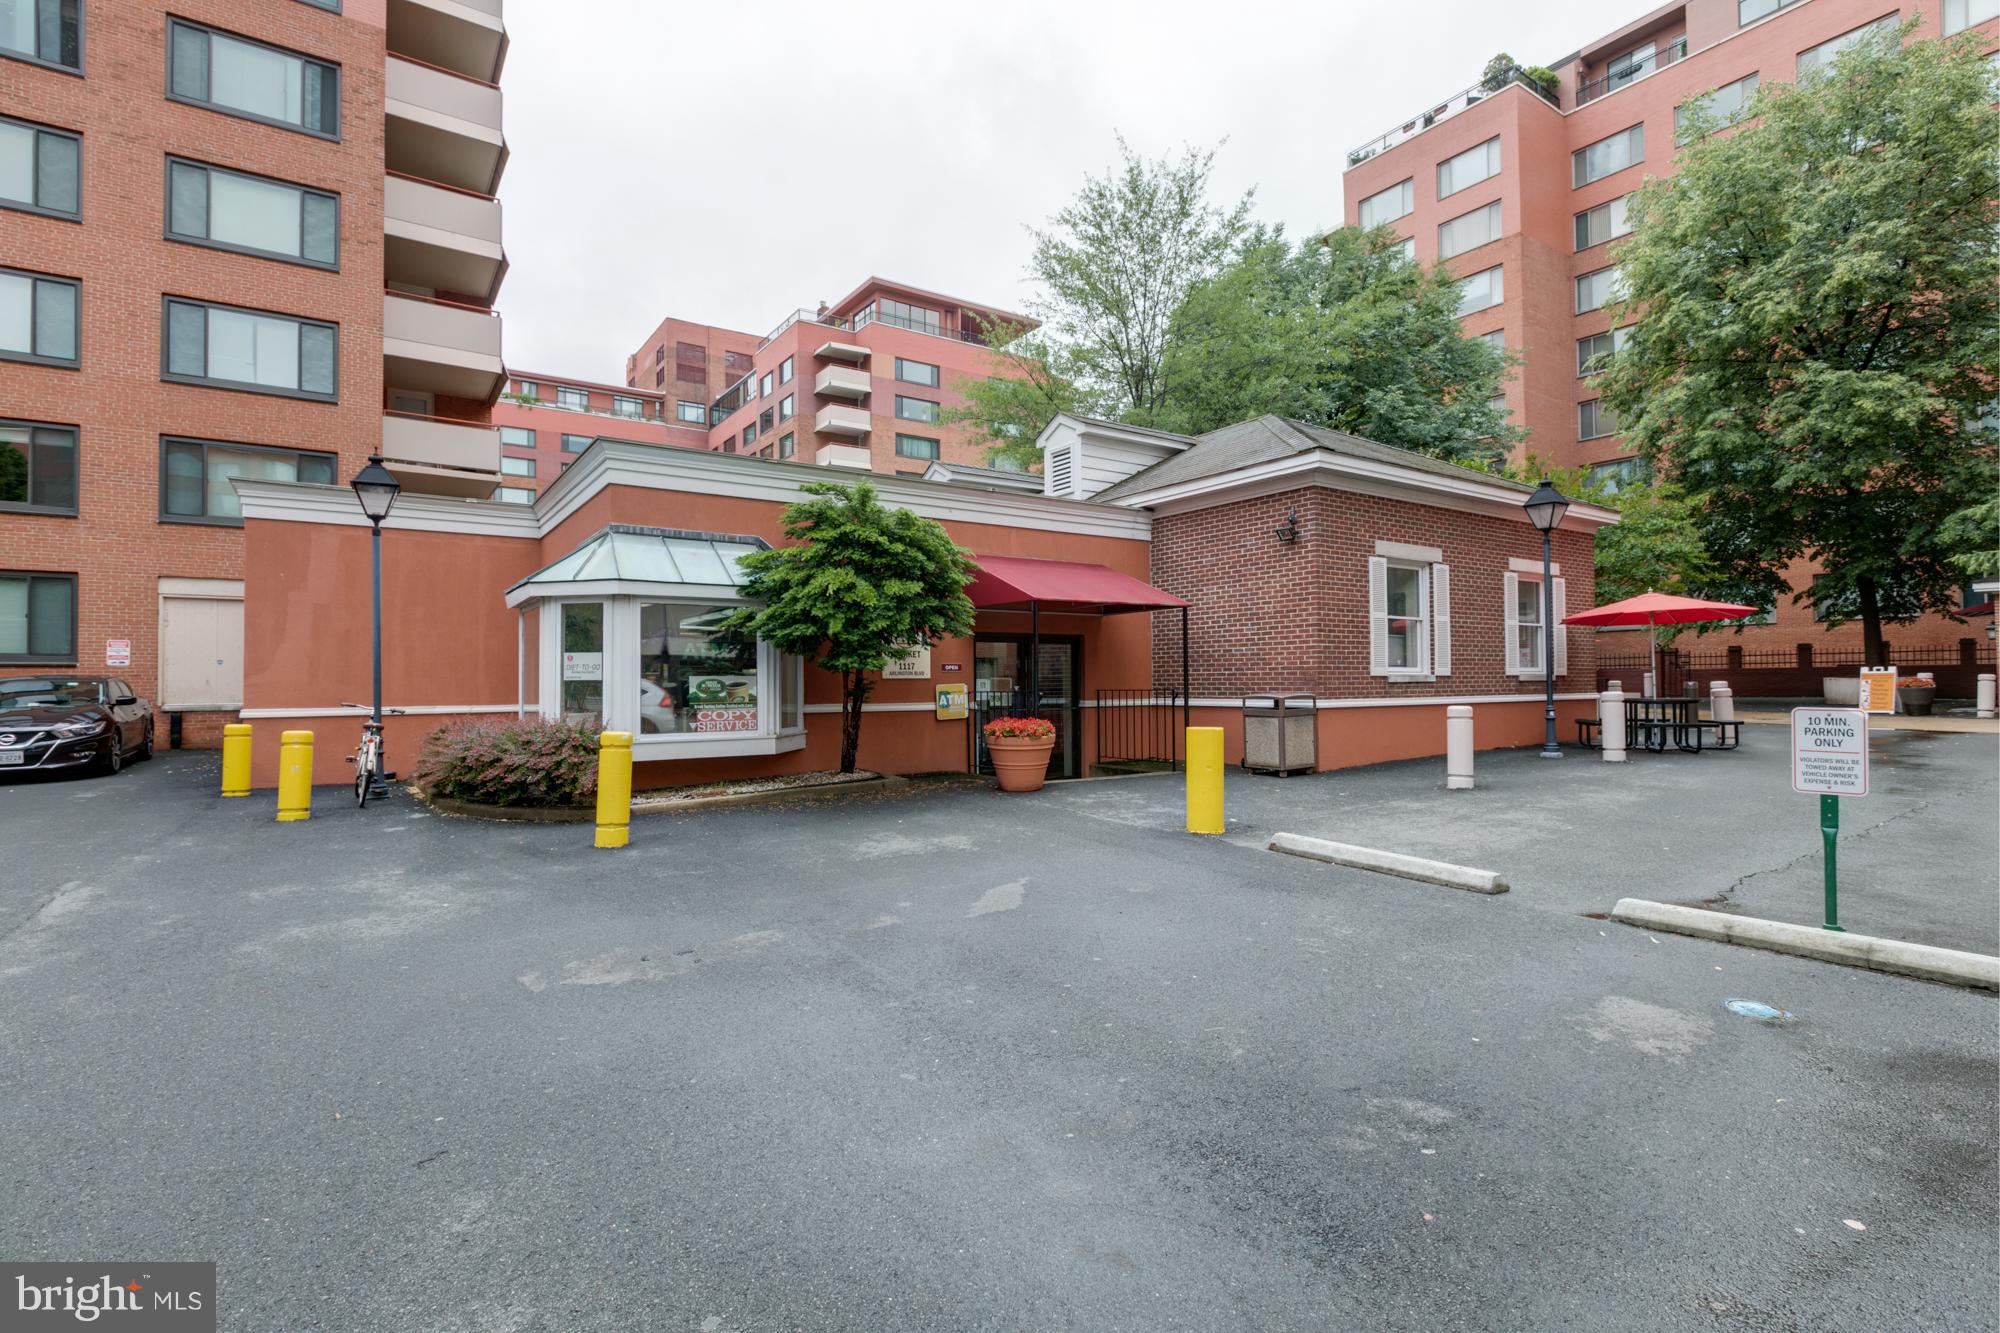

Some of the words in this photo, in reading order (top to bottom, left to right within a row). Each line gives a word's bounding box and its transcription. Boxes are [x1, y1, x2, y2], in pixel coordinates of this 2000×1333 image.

[899, 663, 915, 671] 1117
[939, 694, 964, 705] ATM
[697, 710, 755, 721] COPY
[697, 719, 756, 731] SERVICE
[1808, 717, 1821, 726] 10
[1824, 717, 1851, 726] MIN.
[1804, 728, 1854, 737] PARKING
[1814, 738, 1844, 747] ONLY
